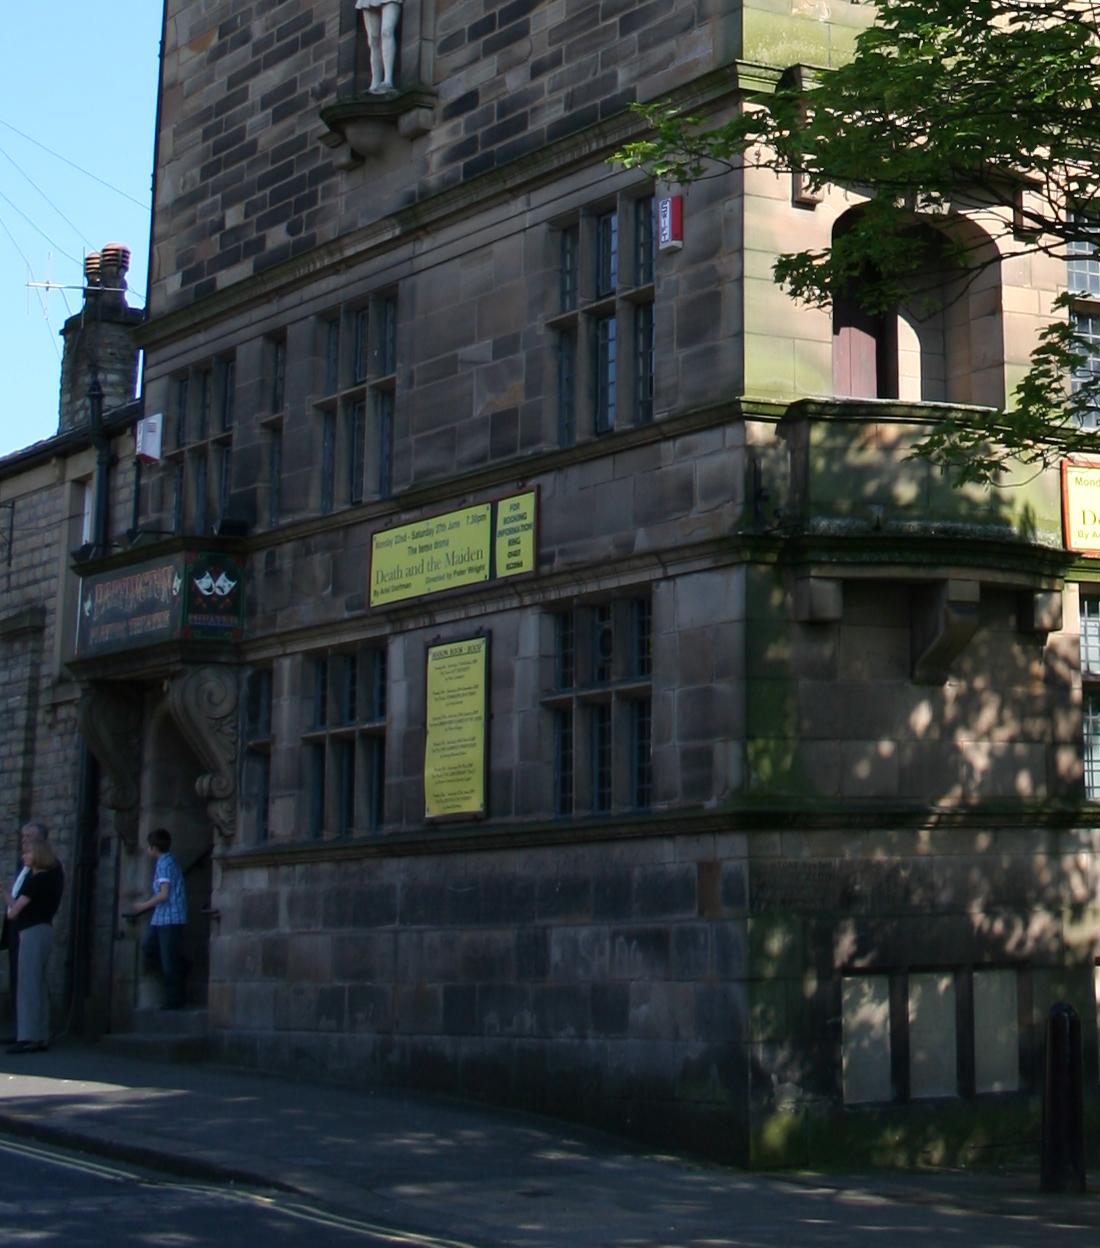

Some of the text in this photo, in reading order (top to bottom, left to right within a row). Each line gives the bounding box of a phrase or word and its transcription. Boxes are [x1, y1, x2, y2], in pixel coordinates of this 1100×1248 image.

[411, 527, 434, 540] Saturday
[496, 523, 535, 538] INFORMATION
[1078, 530, 1089, 540] By
[375, 563, 403, 585] Death
[405, 558, 425, 577] and
[426, 555, 441, 572] the
[445, 546, 485, 567] Maiden
[453, 568, 467, 578] Peter
[467, 563, 486, 575] Wright
